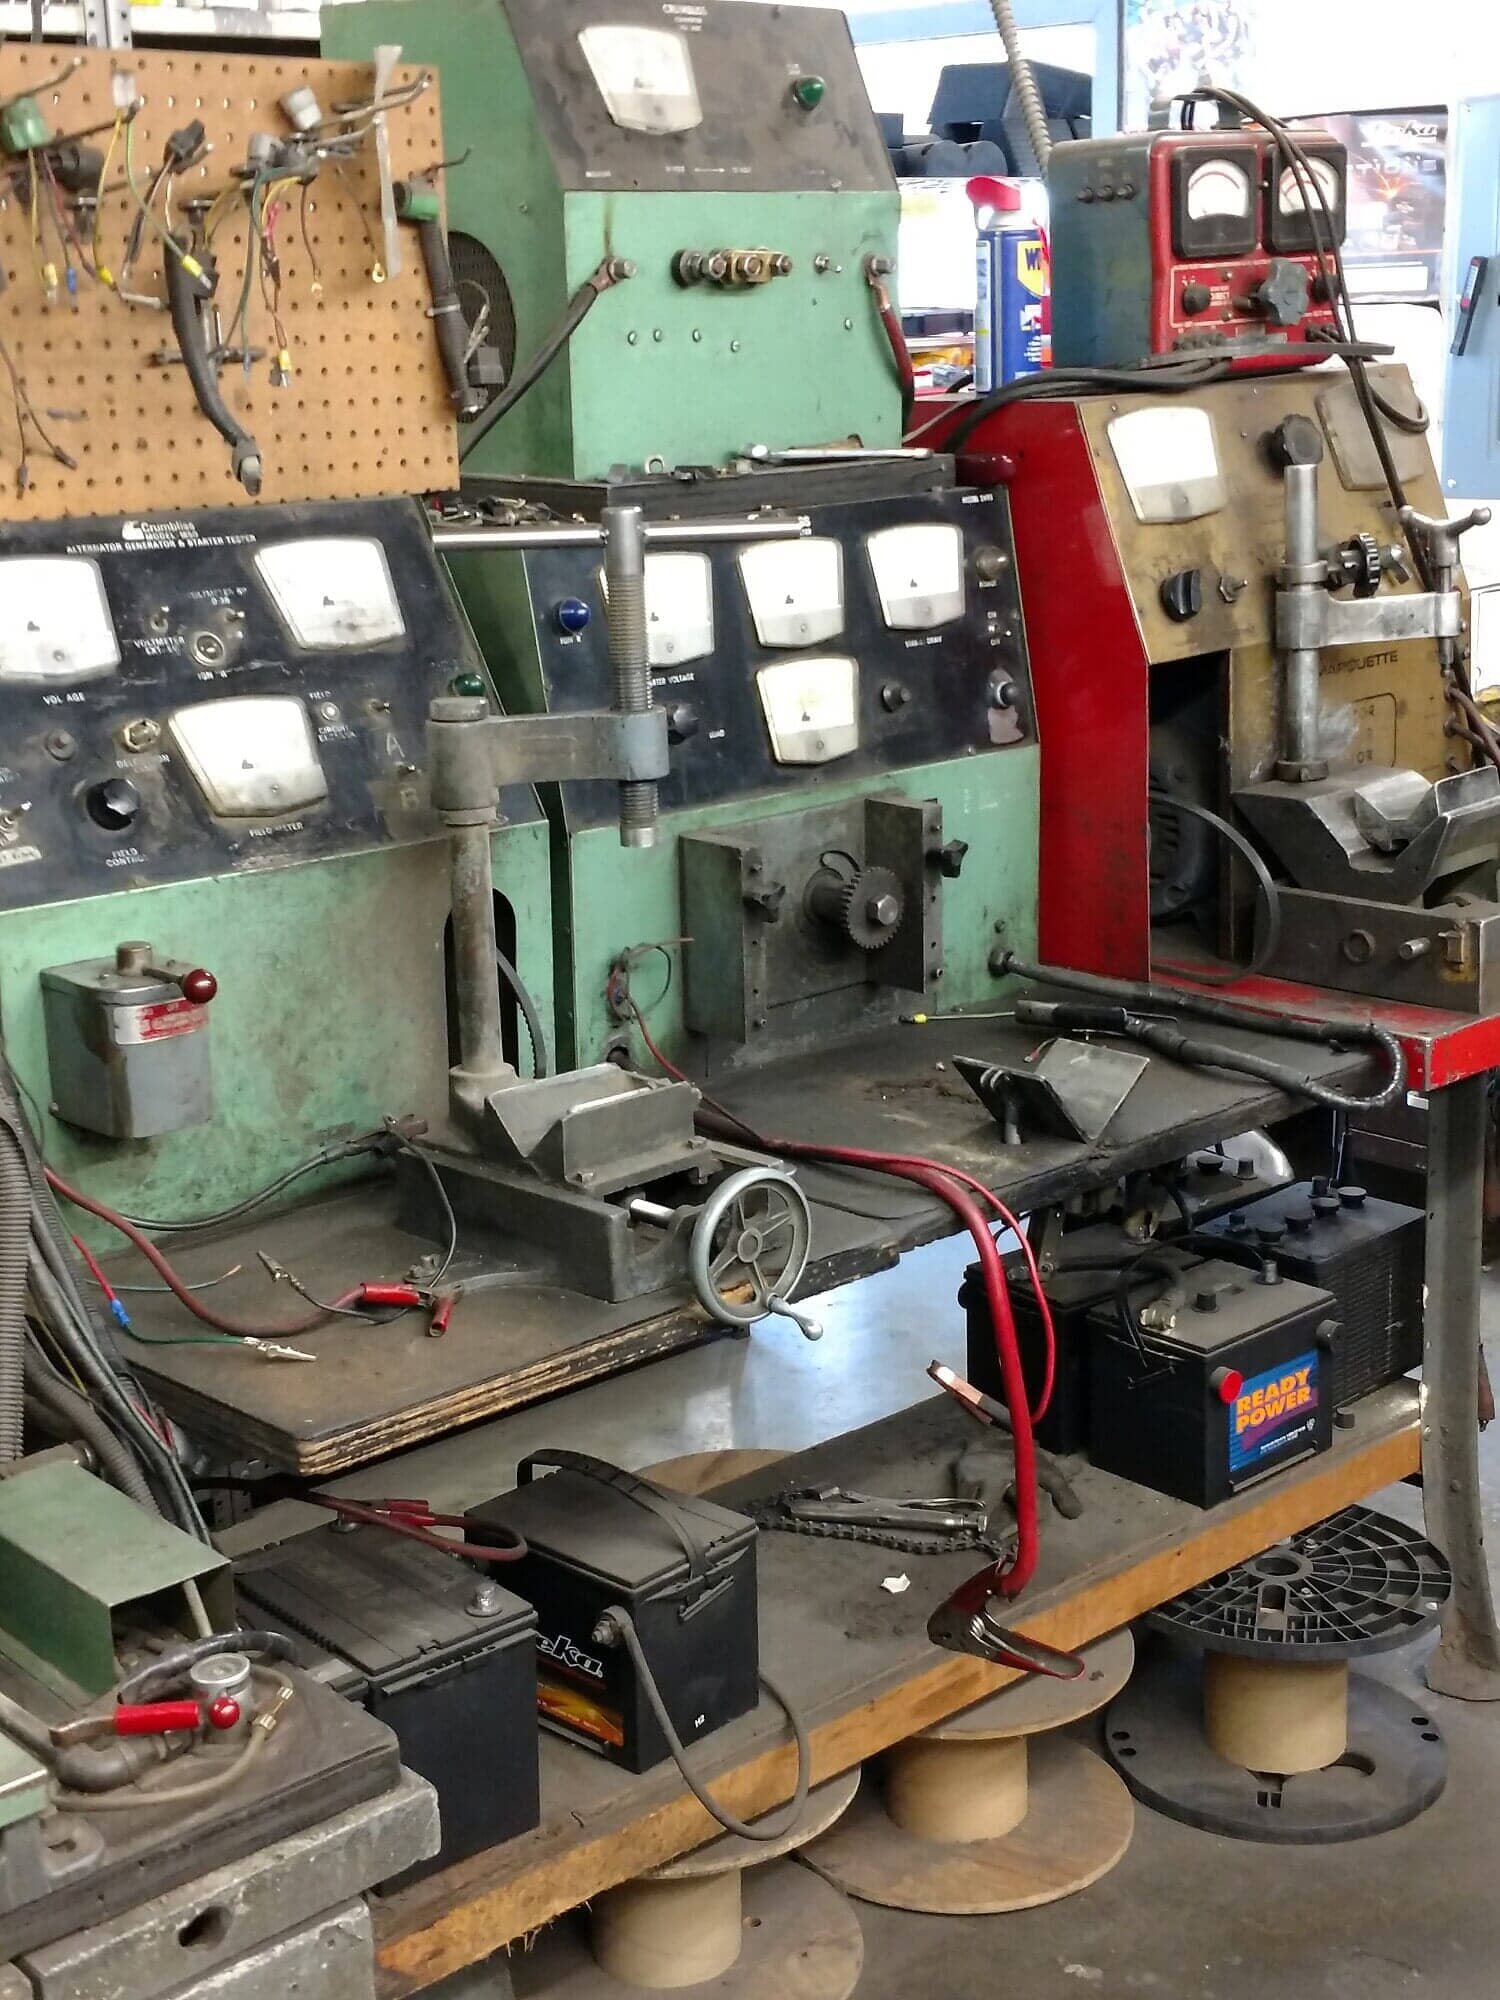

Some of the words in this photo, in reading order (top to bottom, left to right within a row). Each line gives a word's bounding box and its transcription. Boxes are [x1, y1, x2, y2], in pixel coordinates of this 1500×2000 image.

[43, 692, 85, 705] VOLAGE
[1236, 1367, 1311, 1415] READY
[1236, 1387, 1311, 1434] POWER
[536, 1635, 603, 1678] eka
